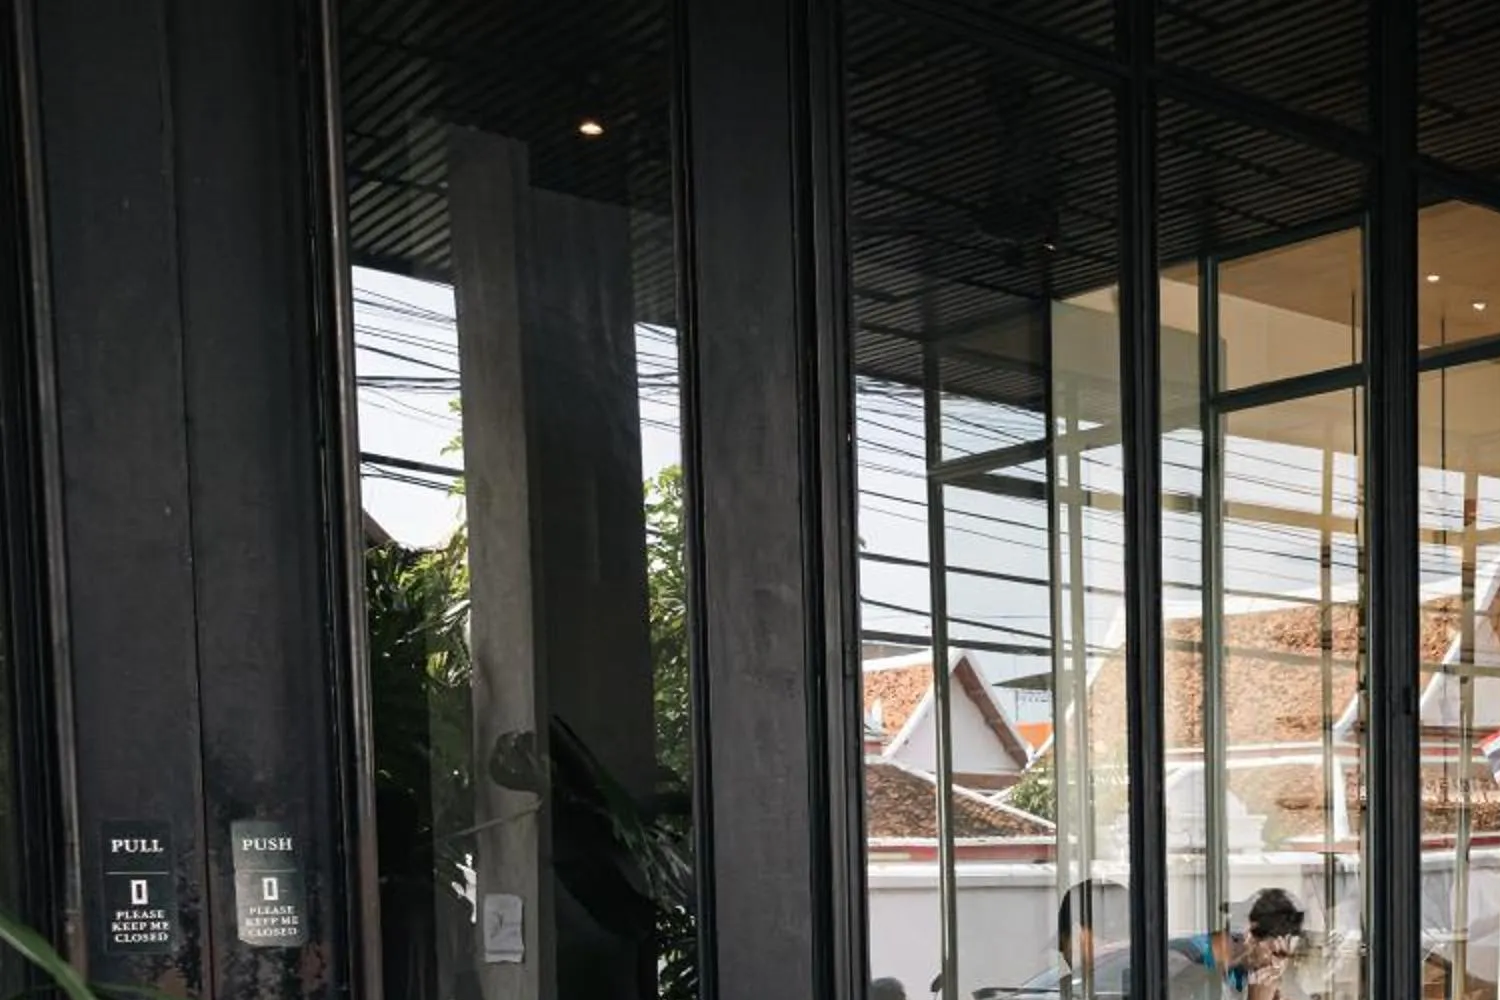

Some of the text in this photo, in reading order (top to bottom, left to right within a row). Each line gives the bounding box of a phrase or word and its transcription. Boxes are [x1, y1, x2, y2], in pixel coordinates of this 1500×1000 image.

[111, 839, 164, 853] PULL
[242, 837, 293, 851] PUSH
[115, 909, 165, 920] PLEASE
[249, 905, 296, 915] PLEASE
[111, 921, 170, 931] KEEP ME
[245, 915, 299, 926] KEEP ME
[114, 932, 169, 943] CLOSED
[248, 927, 297, 937] CLOSED
